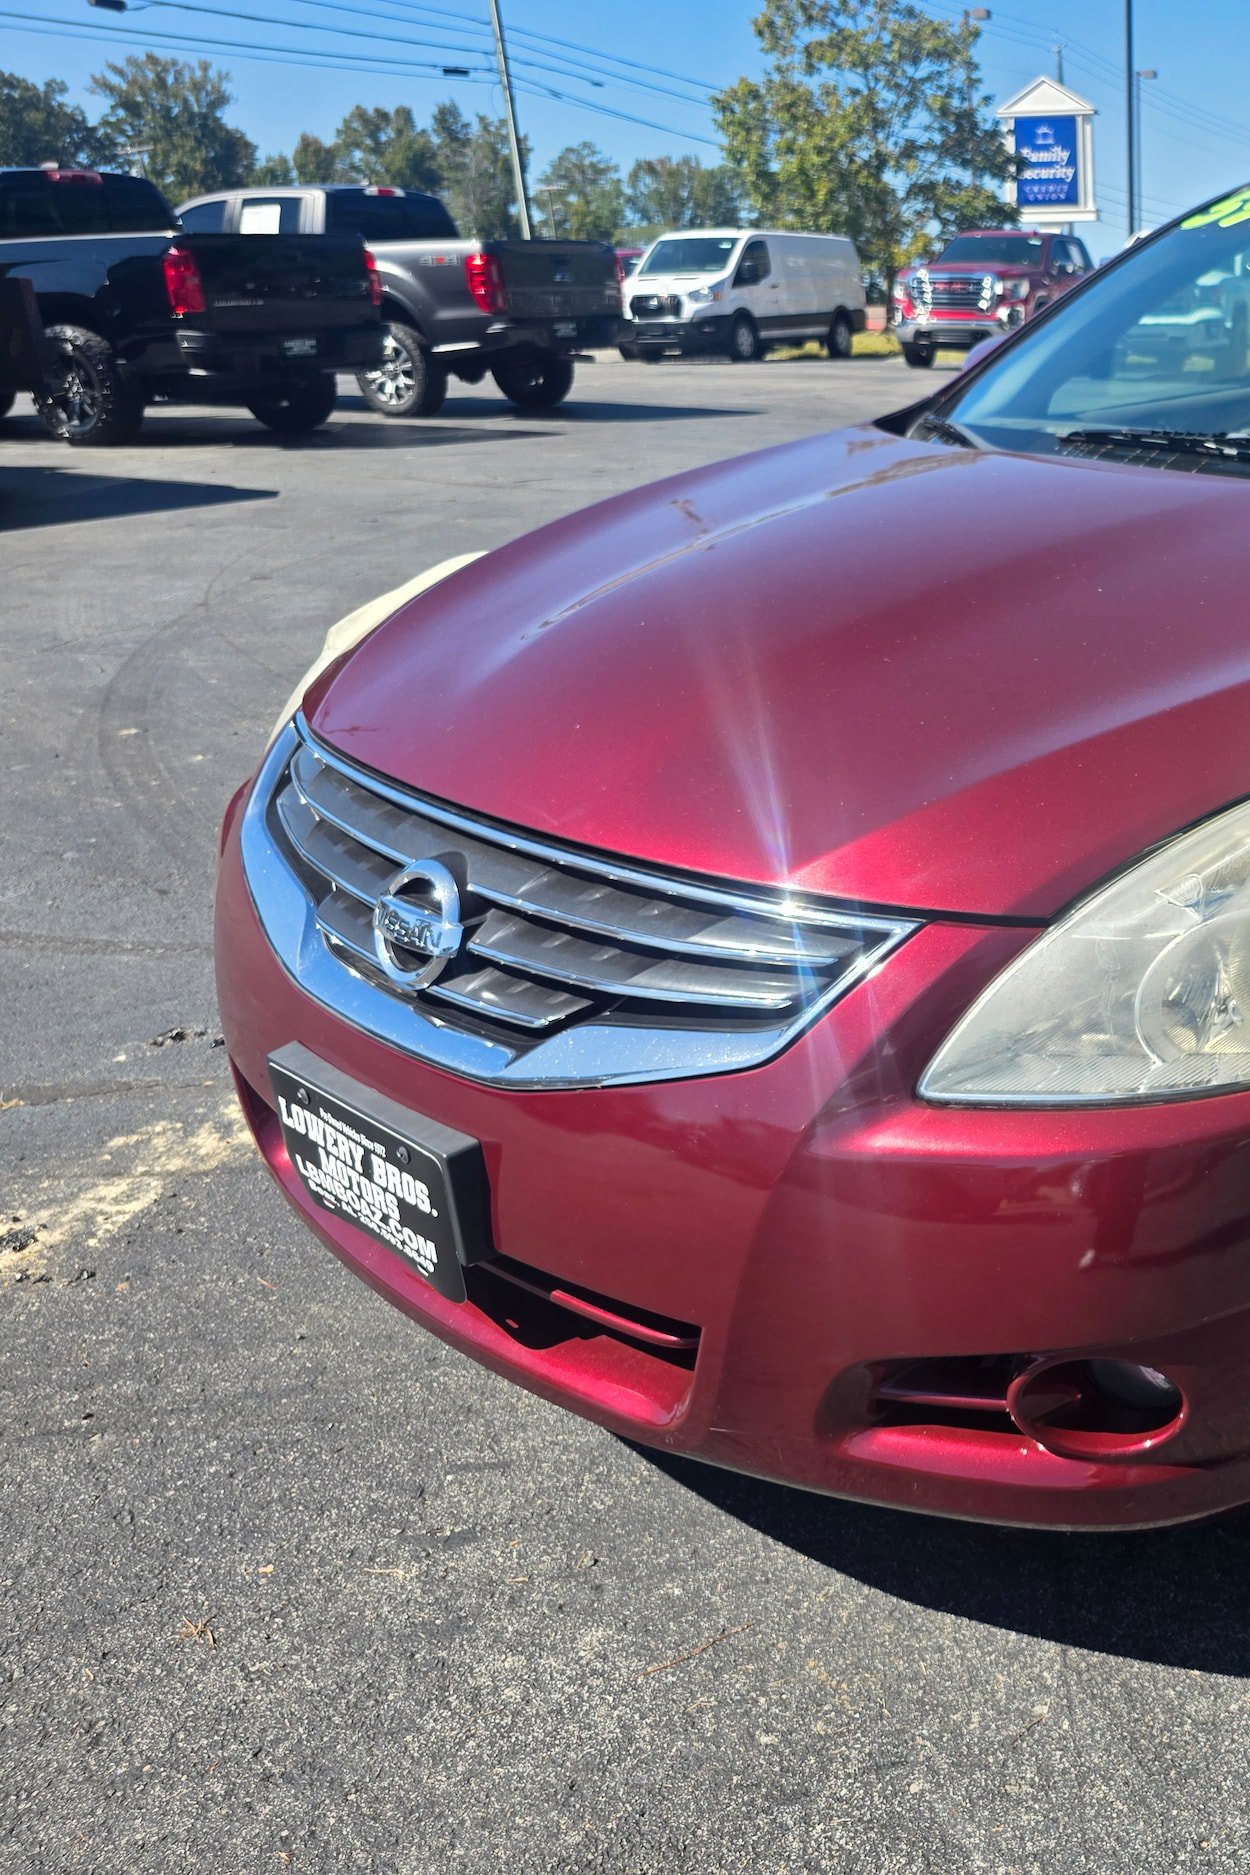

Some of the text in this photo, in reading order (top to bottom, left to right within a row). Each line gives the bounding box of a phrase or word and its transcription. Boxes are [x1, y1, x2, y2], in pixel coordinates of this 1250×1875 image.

[1020, 145, 1071, 166] Family
[1023, 183, 1069, 193] CREDIT
[376, 901, 443, 952] NISSAN
[278, 1095, 438, 1217] LOWERY BROS.
[318, 1147, 401, 1221] MOTORS
[295, 1154, 438, 1263] LBMBOAZ.COM
